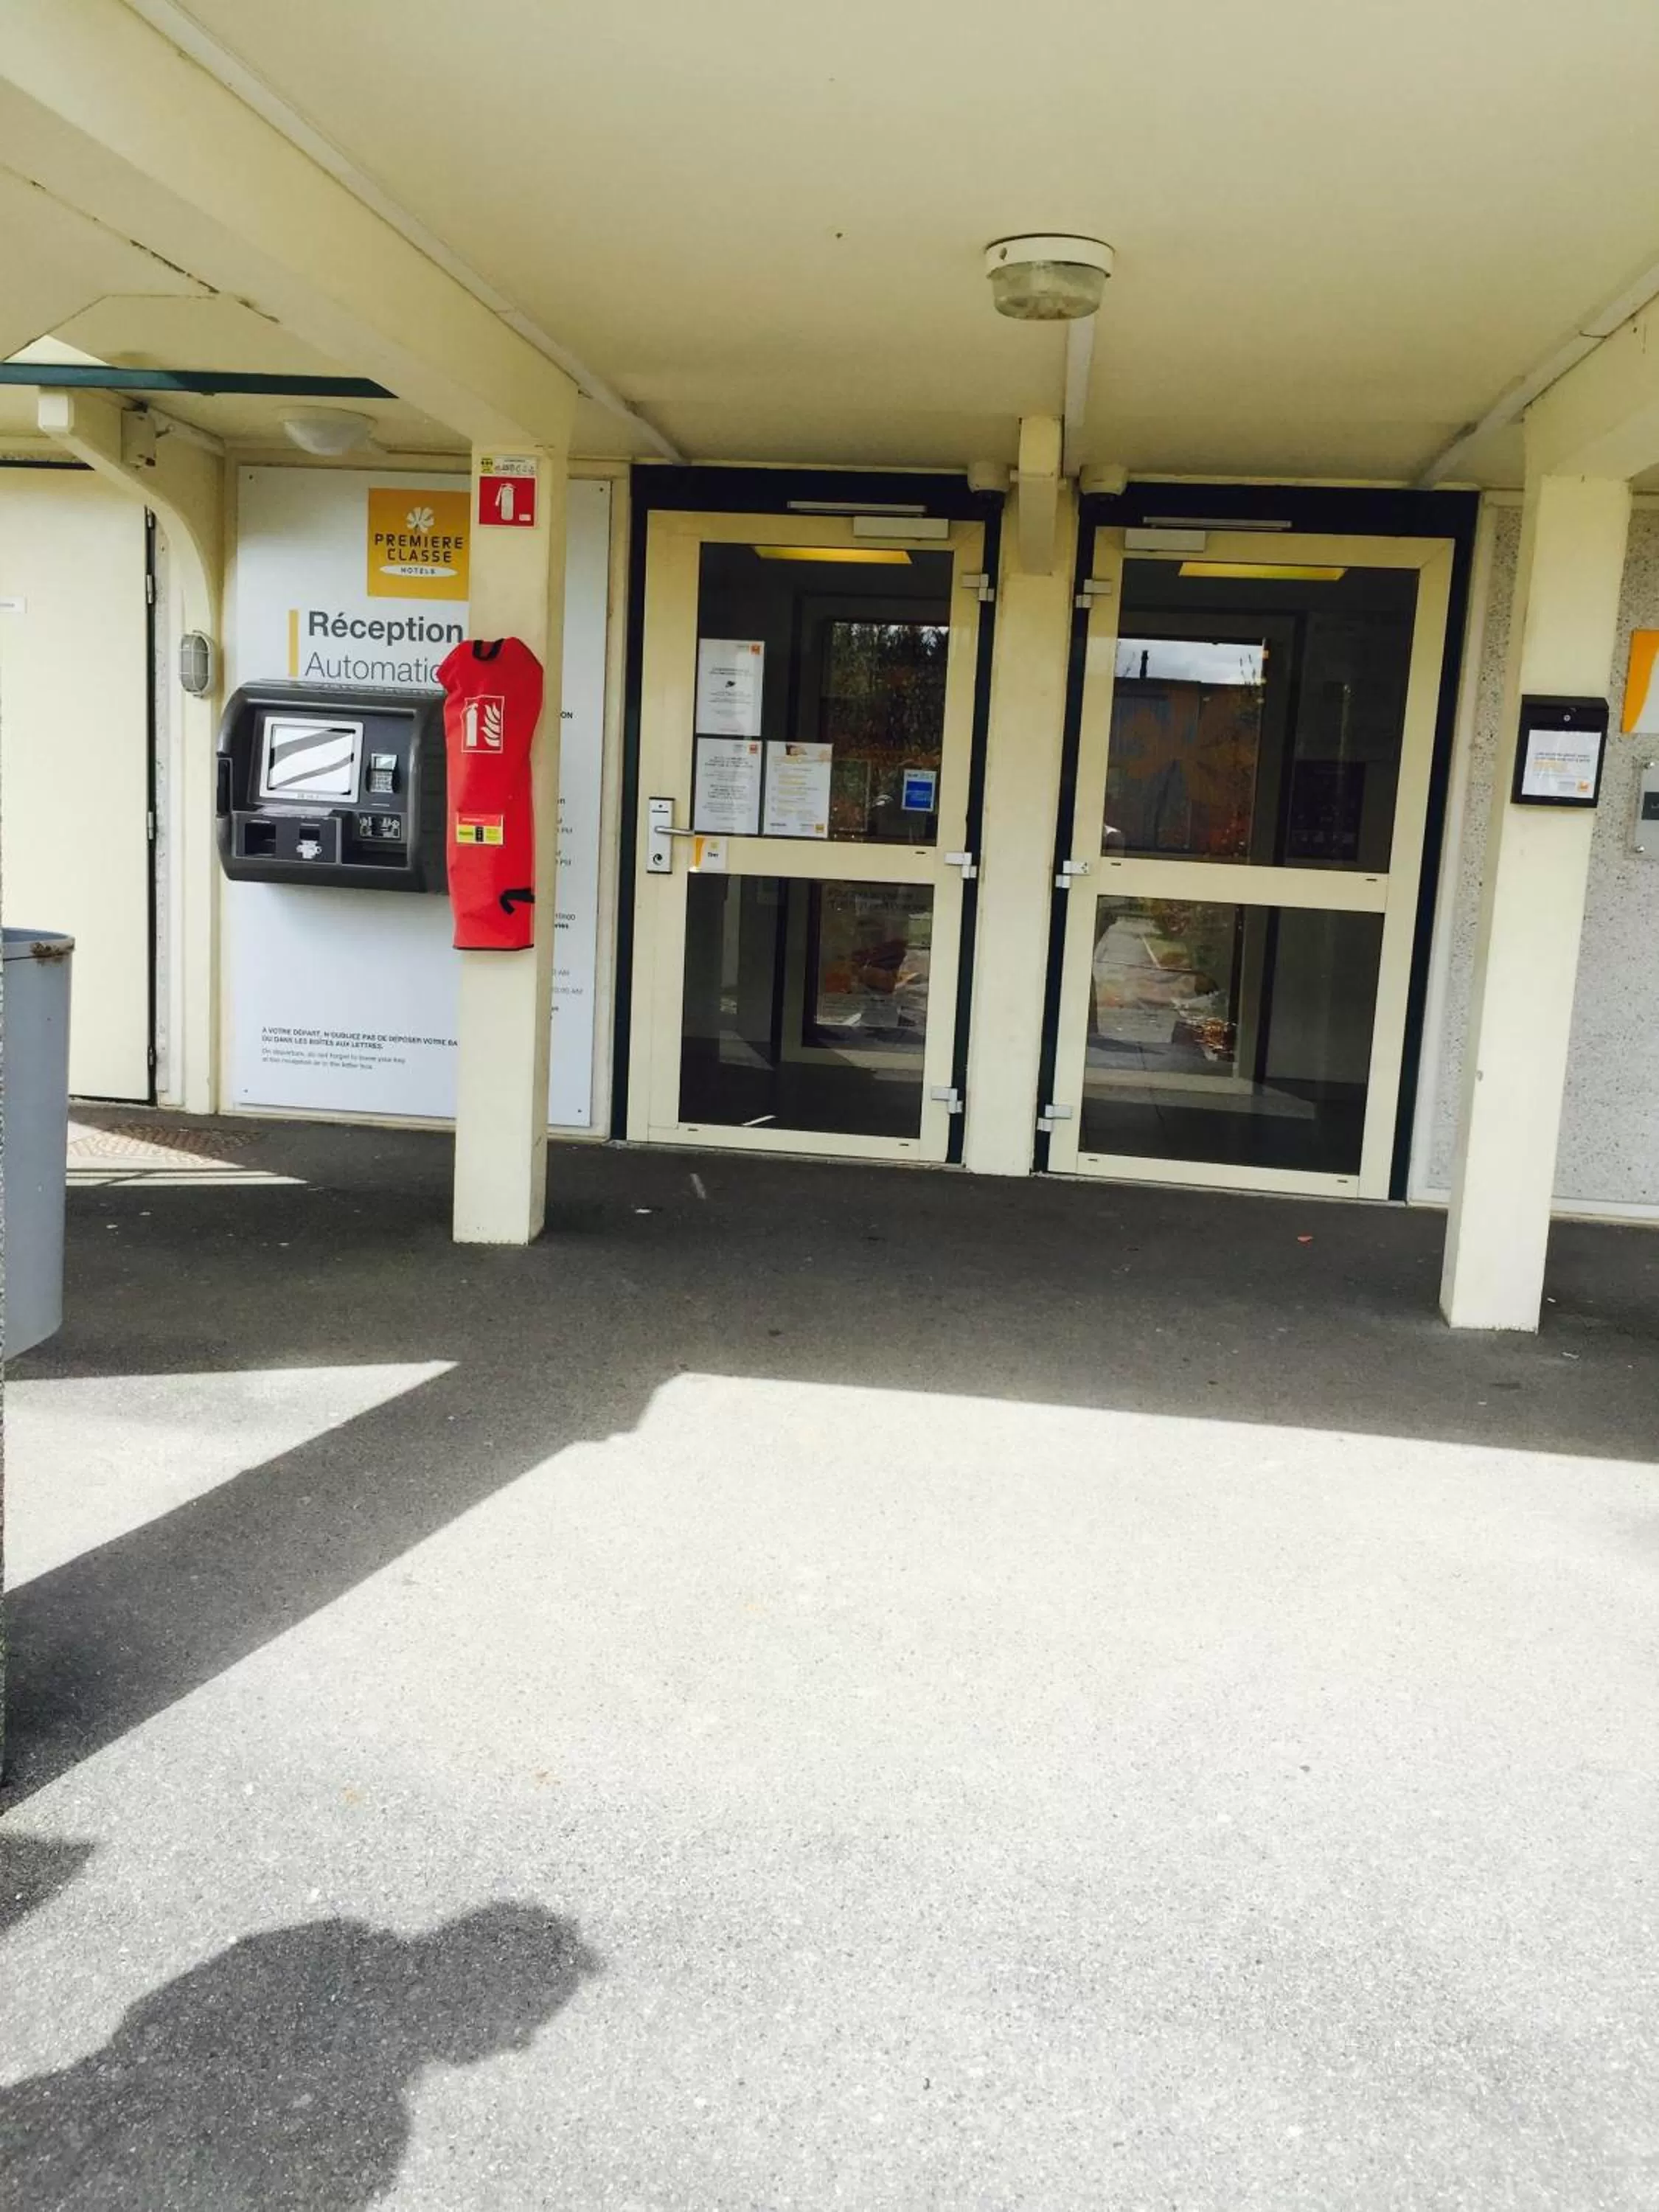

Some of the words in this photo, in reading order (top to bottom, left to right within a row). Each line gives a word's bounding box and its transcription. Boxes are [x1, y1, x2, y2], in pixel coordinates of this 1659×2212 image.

[375, 533, 464, 549] PREMIERE
[387, 548, 452, 563] CLASSE
[400, 567, 436, 575] HOTELS
[309, 611, 464, 647] Réception
